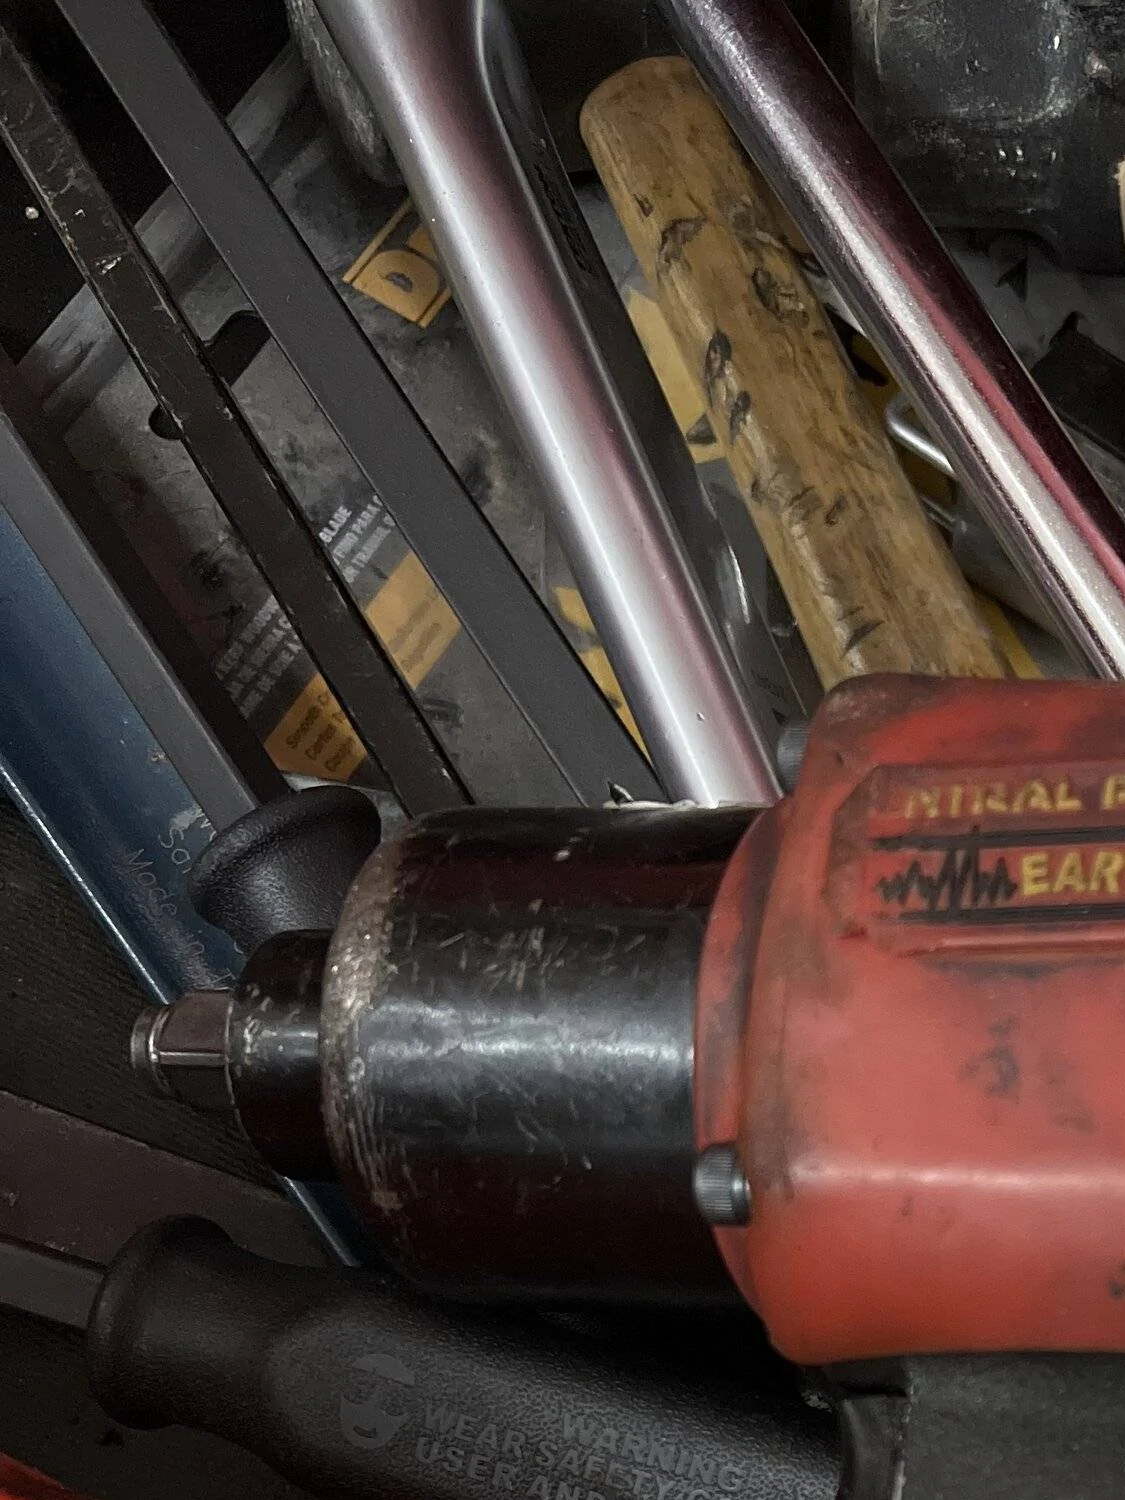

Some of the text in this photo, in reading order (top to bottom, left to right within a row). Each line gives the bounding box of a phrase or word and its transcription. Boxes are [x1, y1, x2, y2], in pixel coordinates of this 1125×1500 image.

[415, 1436, 516, 1491] USER
[424, 1402, 528, 1458] WEAR
[536, 1440, 677, 1500] SAFETY
[562, 1413, 745, 1492] WARNING
